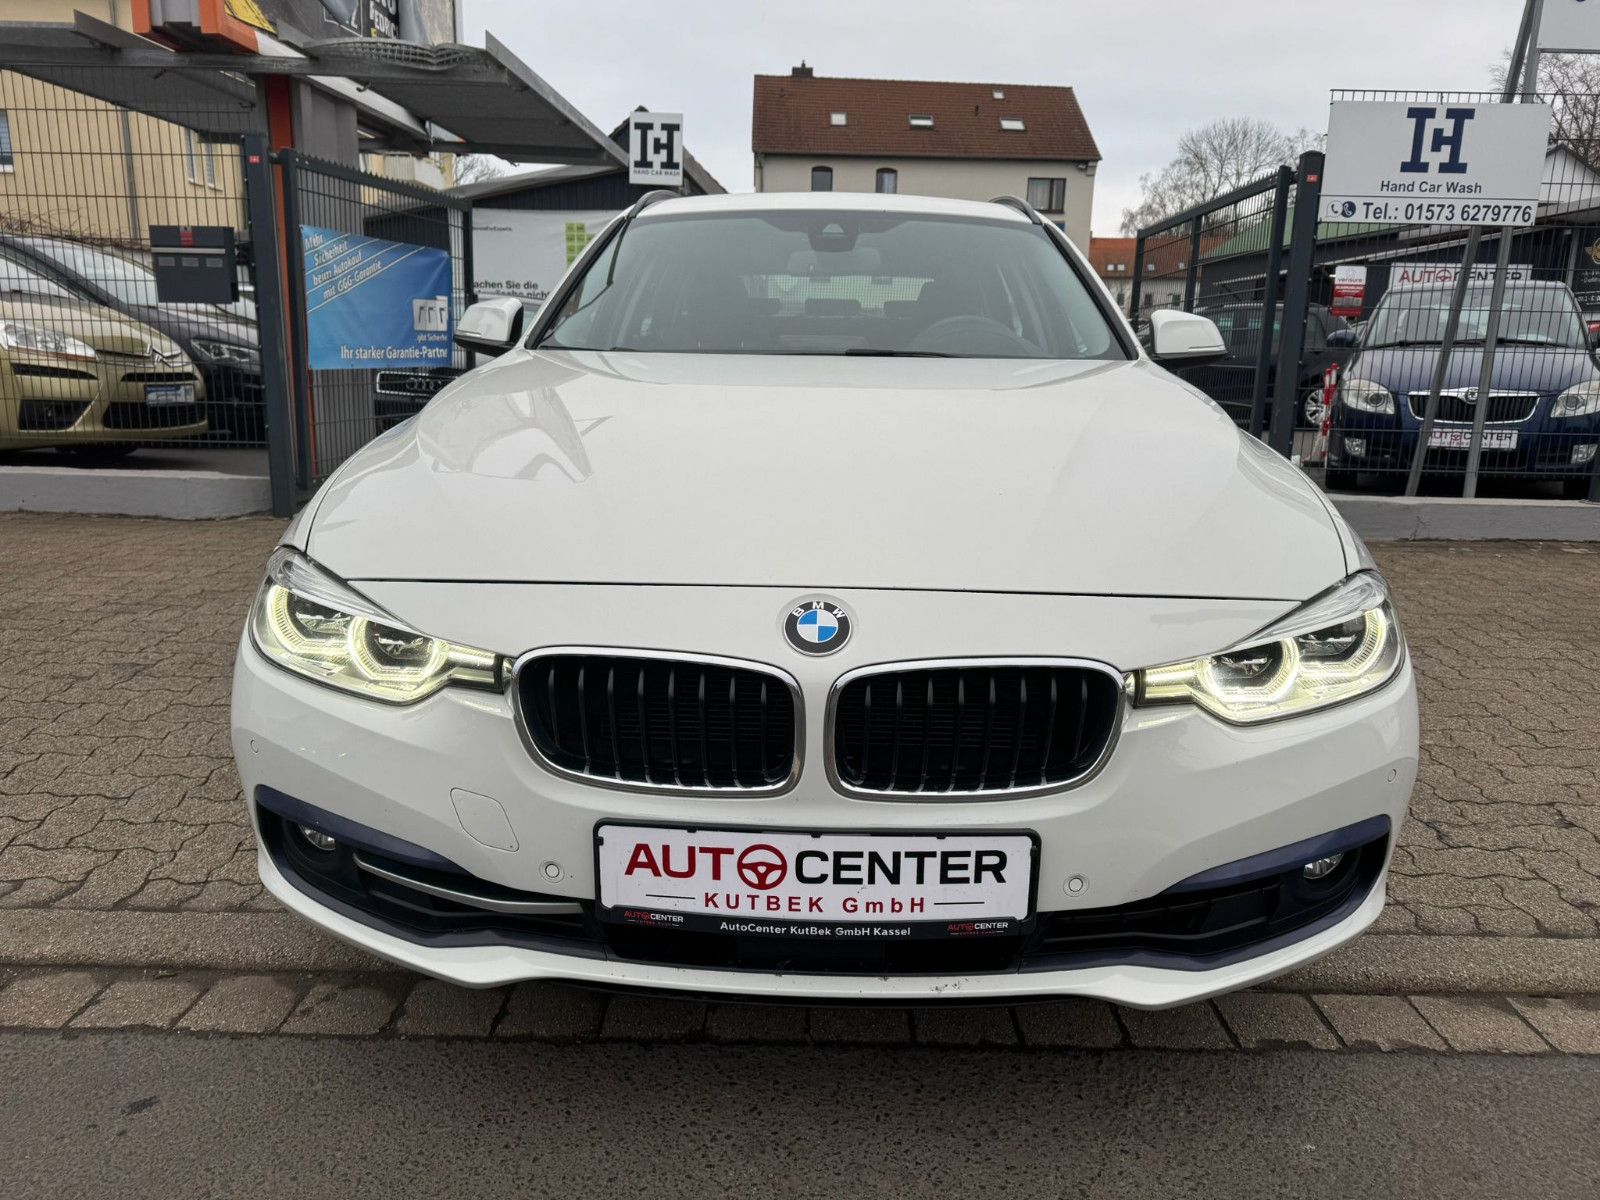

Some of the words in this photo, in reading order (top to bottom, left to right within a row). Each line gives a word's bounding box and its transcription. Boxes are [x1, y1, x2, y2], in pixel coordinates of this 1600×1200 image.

[1380, 180, 1415, 193] Hand
[1418, 181, 1442, 194] Car
[1446, 182, 1482, 194] Wash
[1362, 202, 1398, 220] Tel.:
[1404, 203, 1455, 221] 01573
[1460, 204, 1532, 223] 6279776
[313, 240, 348, 266] Sicherheit
[312, 270, 332, 286] beim
[333, 251, 363, 275] Autokauf
[323, 284, 336, 298] mit
[505, 280, 521, 290] Sie
[524, 281, 538, 290] die
[341, 345, 353, 359] Ihr
[356, 346, 384, 360] starker
[791, 601, 846, 618] BMW
[704, 892, 824, 913] KUTBEK
[842, 896, 925, 914] GmbH
[720, 922, 787, 934] AutoCenter
[790, 924, 832, 936] KutBek
[835, 926, 870, 936] GmbH
[873, 926, 911, 936] Kassel
